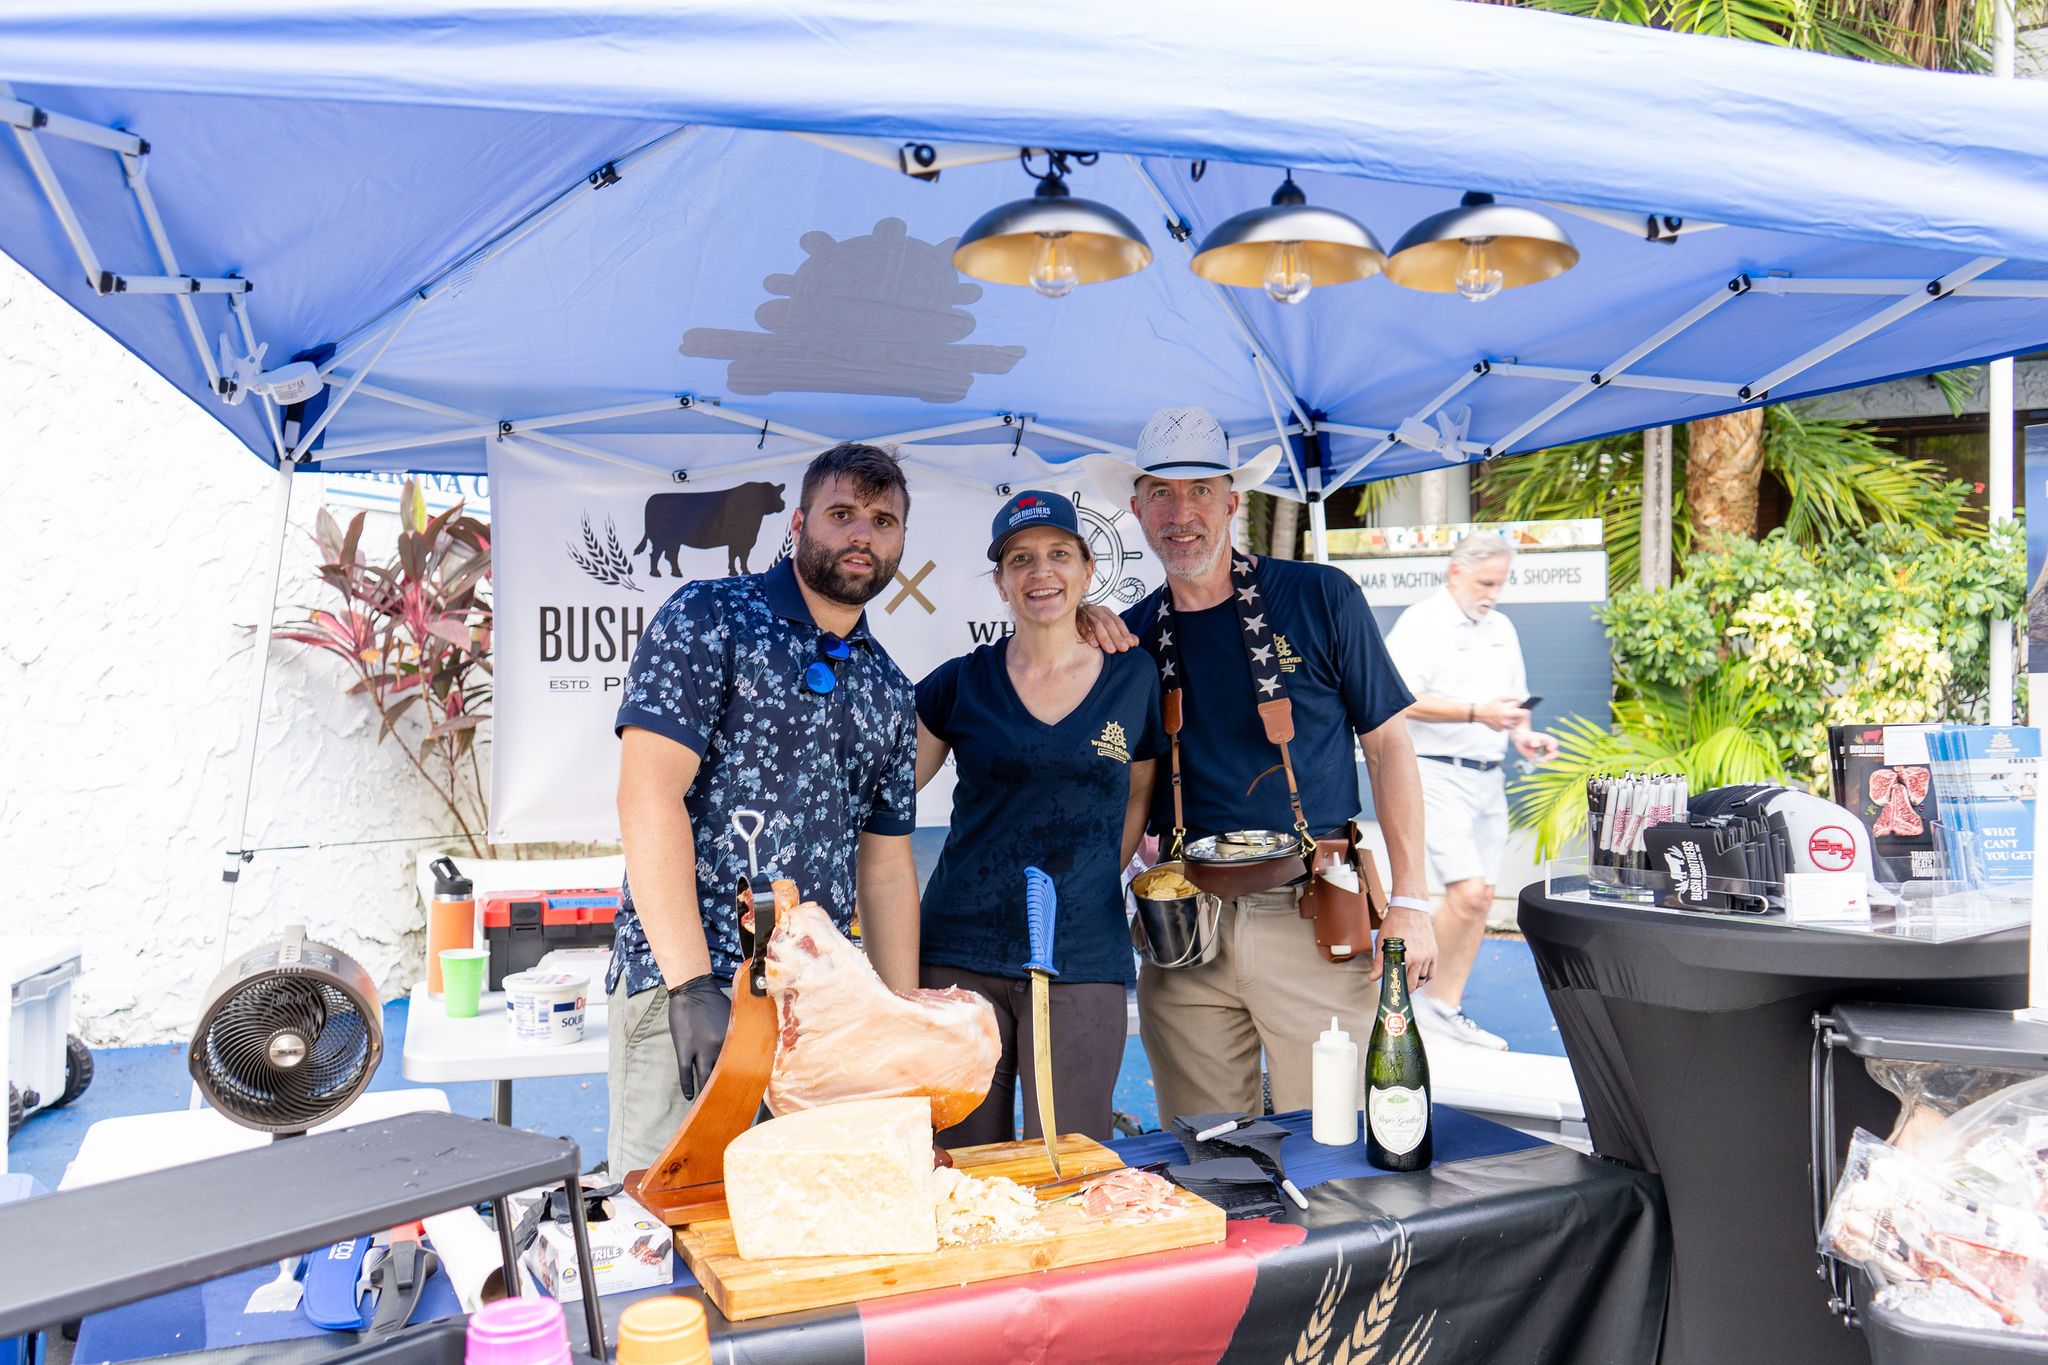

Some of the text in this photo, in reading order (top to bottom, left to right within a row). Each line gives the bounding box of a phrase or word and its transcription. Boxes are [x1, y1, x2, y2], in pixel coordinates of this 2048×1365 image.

[1360, 573, 1387, 588] MAR
[1509, 570, 1518, 585] &
[1524, 567, 1582, 585] SHOPPES
[540, 606, 643, 662] BUSH
[967, 621, 1016, 644] WH
[549, 680, 589, 689] ESTD
[1982, 827, 2016, 837] WHAT
[1984, 839, 2019, 849] CAN'T
[1682, 840, 1701, 878] BROTHERS
[1984, 851, 2010, 861] YOU
[1690, 877, 1702, 901] BUSH
